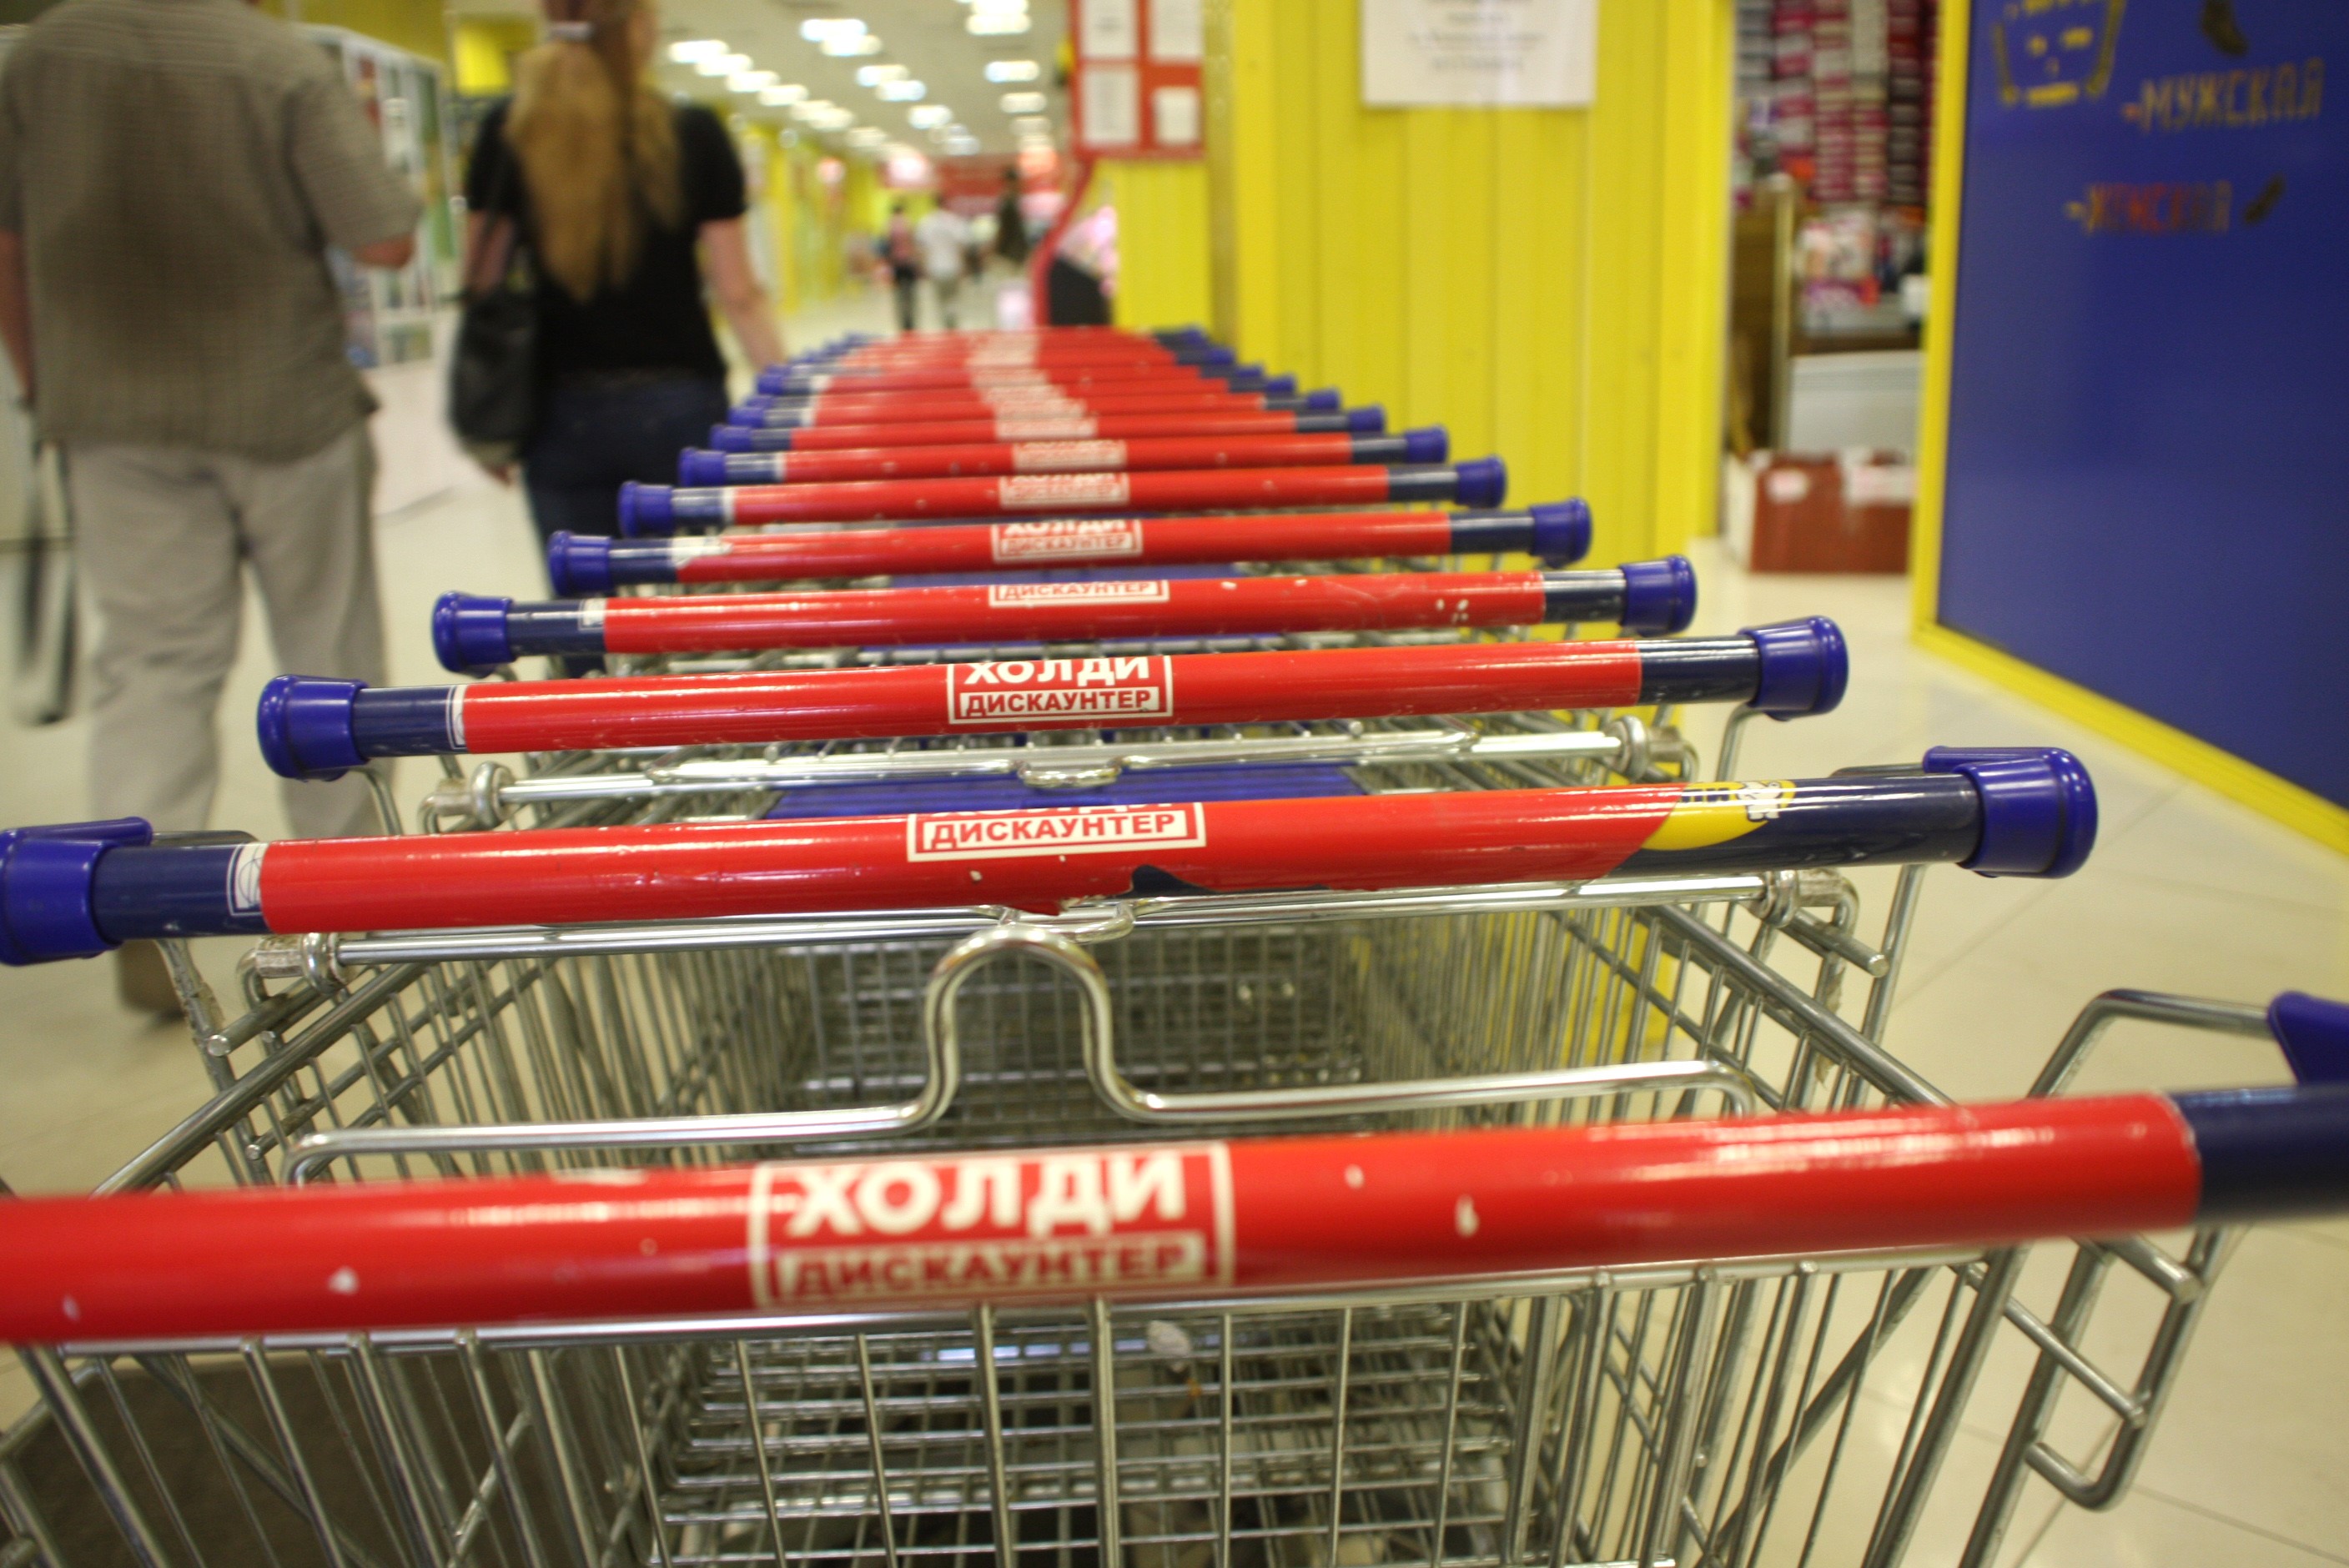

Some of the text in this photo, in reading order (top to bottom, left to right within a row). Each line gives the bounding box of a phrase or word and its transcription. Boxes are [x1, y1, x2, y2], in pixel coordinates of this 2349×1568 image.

[1004, 581, 1150, 600] ДИСКАУНТЕР
[963, 656, 1149, 686] ХОЛДИ
[965, 690, 1151, 717] ДИСКАУНТЕР
[931, 813, 1175, 850] ДИСКАУНТЕР
[786, 1150, 1187, 1238] ХОЛДИ
[794, 1239, 1188, 1299] ДИСКАУНТЕР
